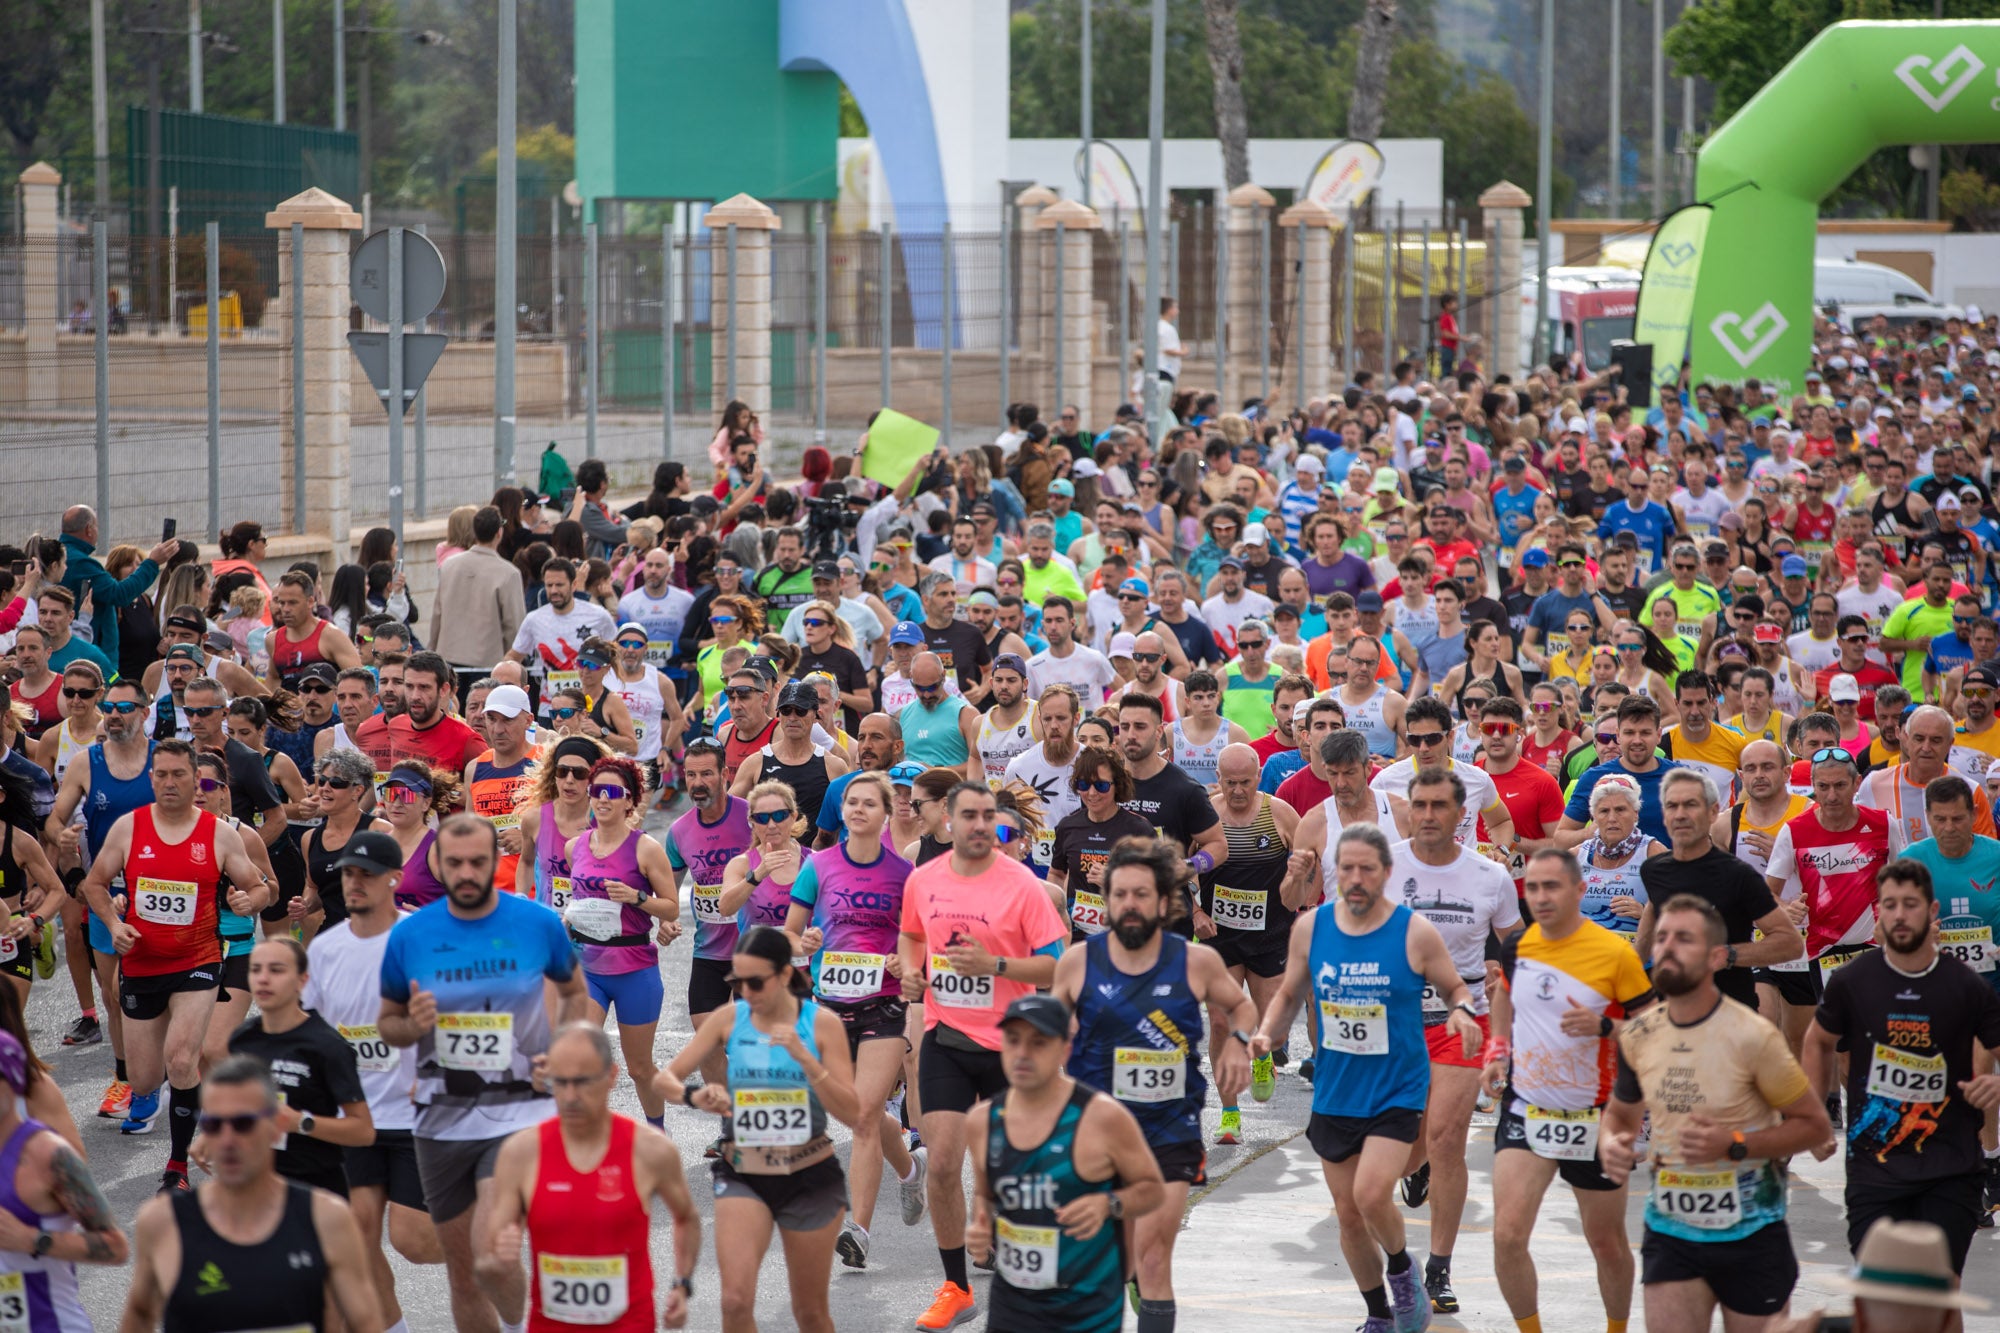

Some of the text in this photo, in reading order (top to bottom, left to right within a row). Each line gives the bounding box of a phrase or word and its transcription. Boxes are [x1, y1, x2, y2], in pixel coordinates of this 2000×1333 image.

[1345, 721, 1375, 729] ACENA
[1142, 800, 1161, 809] BOX
[146, 880, 155, 889] 38
[1585, 887, 1635, 897] ARACENA
[144, 894, 186, 913] 393
[1221, 889, 1257, 900] 38 FONDO
[1073, 906, 1107, 925] 22
[1214, 900, 1264, 919] 3356
[1940, 920, 1985, 929] NNOVENT
[1948, 932, 1980, 941] FONDO
[832, 956, 872, 964] 38 FONDO
[1340, 962, 1379, 975] TEAM
[822, 968, 878, 986] 4001
[932, 973, 990, 995] 4005
[1339, 975, 1391, 986] RUNNING
[1339, 1021, 1368, 1041] 36
[1887, 1020, 1930, 1032] FONDO
[446, 1034, 499, 1055] 732
[1888, 1031, 1932, 1048] 2025
[1127, 1069, 1175, 1088] 139
[1662, 1078, 1700, 1093] Media
[1876, 1063, 1943, 1090] 1026
[737, 1108, 807, 1131] 4032
[1536, 1123, 1587, 1145] 492
[1661, 1190, 1736, 1213] 1024
[552, 1280, 611, 1306] 200
[2, 1296, 23, 1320] 3
